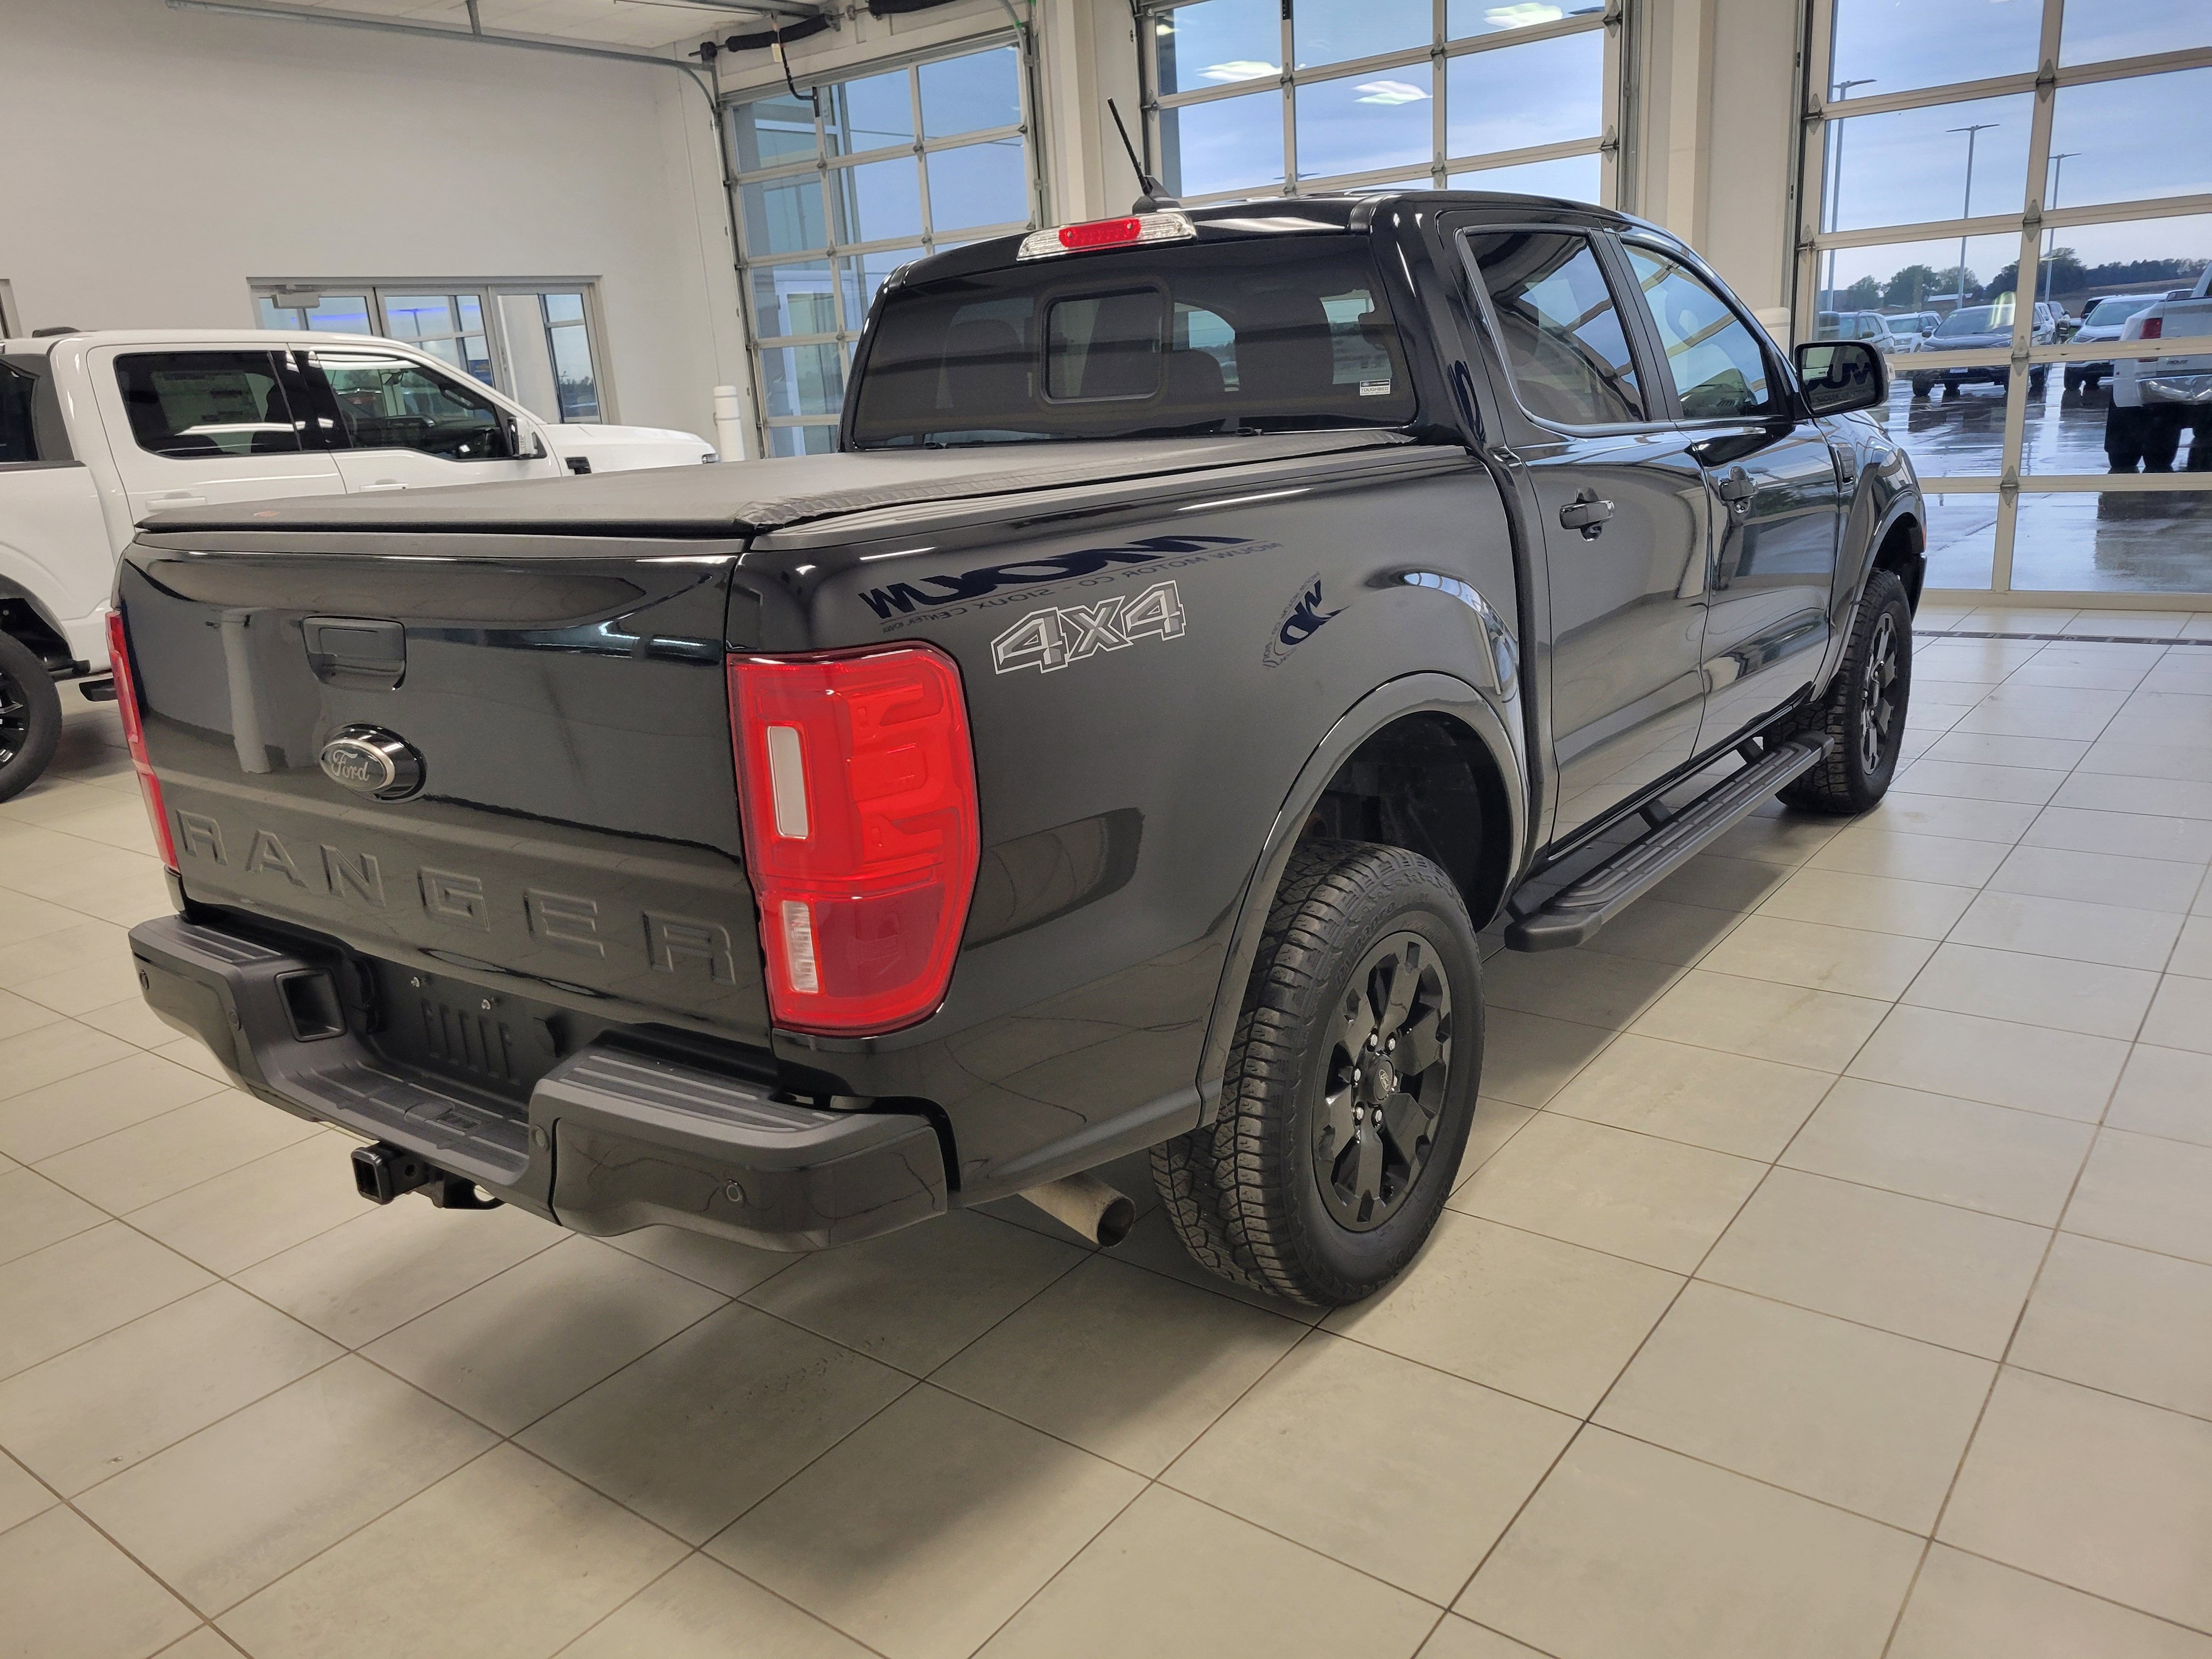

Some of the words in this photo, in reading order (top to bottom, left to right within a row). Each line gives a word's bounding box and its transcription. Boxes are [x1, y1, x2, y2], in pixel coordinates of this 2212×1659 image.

[331, 749, 370, 782] Ford
[174, 809, 737, 985] RANGER
[1380, 1073, 1389, 1089] Ford
